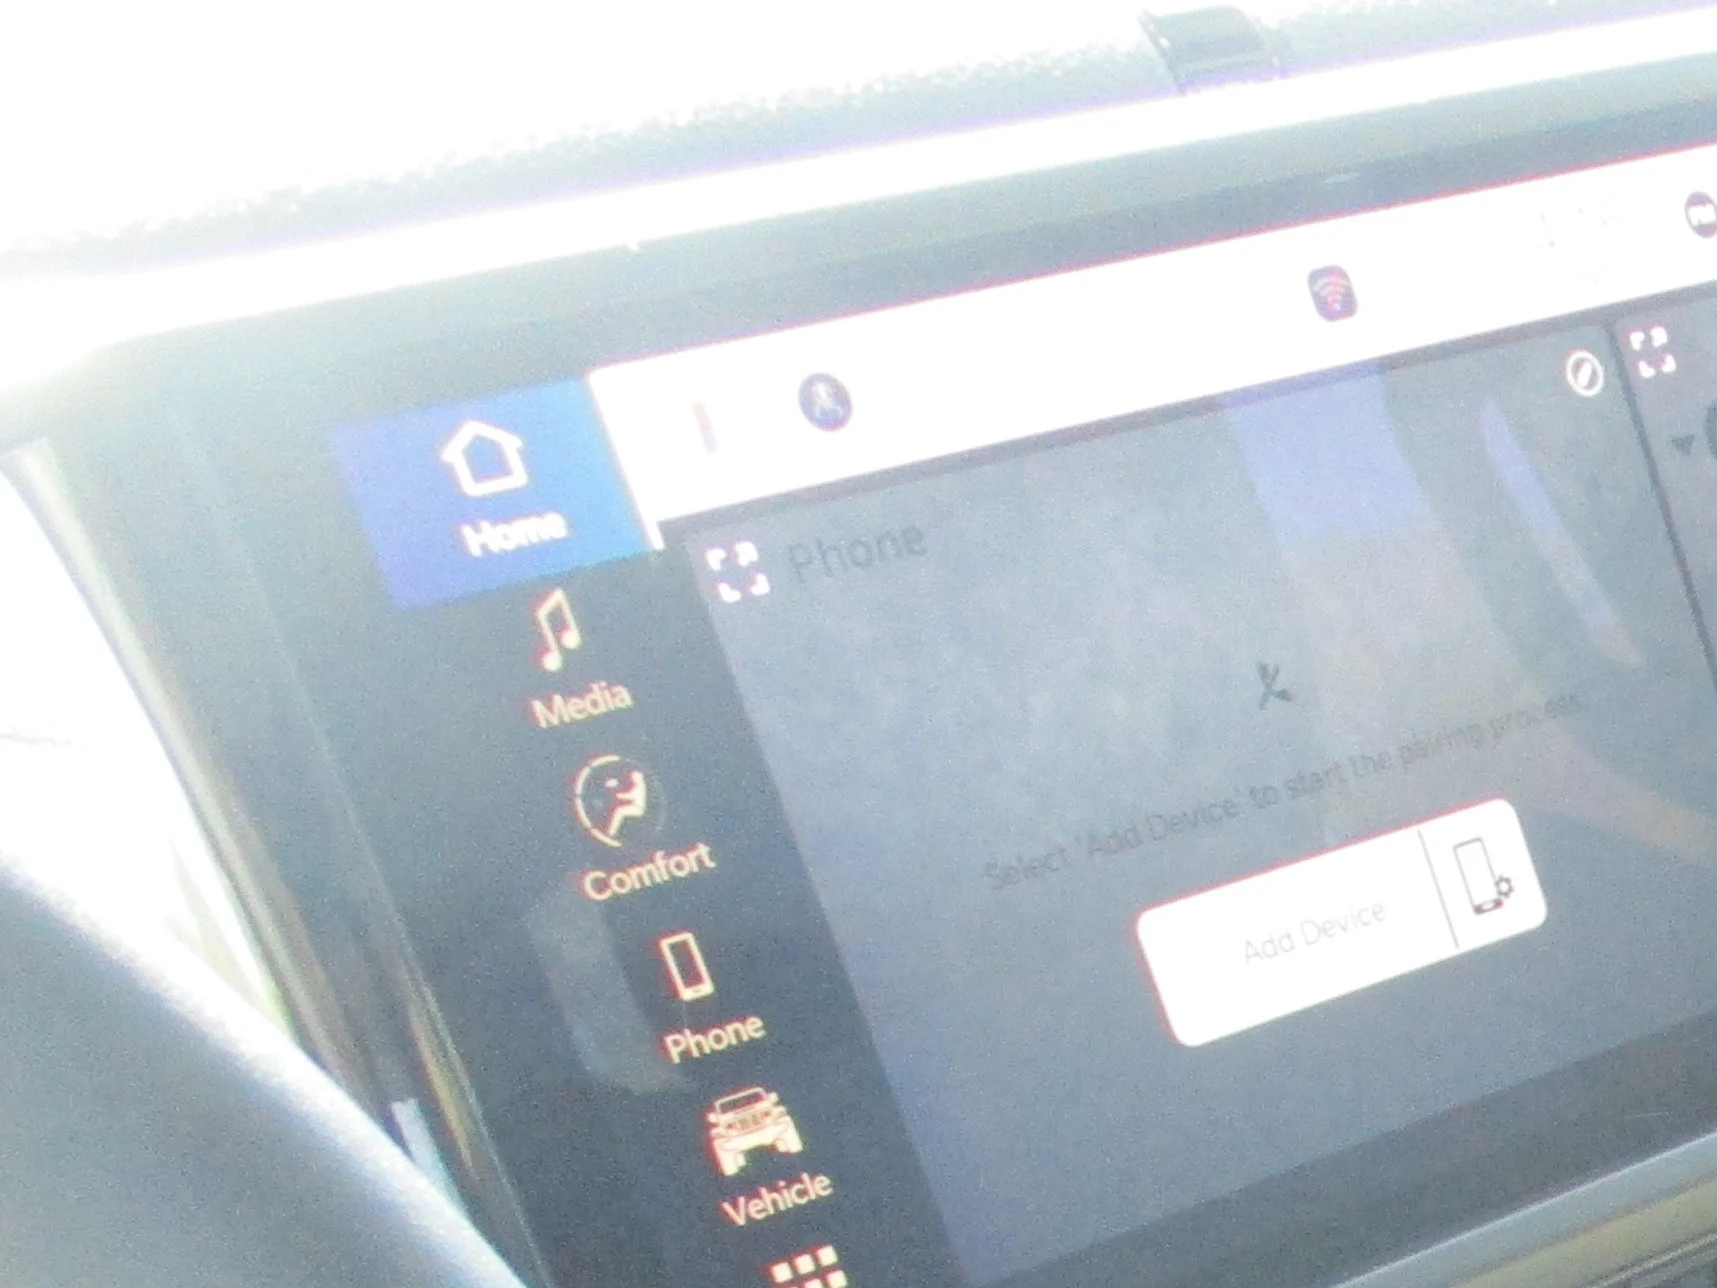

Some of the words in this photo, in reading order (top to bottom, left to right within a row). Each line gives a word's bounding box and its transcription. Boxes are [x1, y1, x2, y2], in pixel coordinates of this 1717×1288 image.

[460, 509, 569, 557] Home
[787, 524, 928, 585] Phone
[530, 681, 633, 728] Media
[583, 841, 718, 903] Comfort
[1243, 924, 1295, 967] Add
[1299, 901, 1387, 946] Device
[663, 1014, 766, 1063] Phone
[721, 1171, 834, 1227] Vehicle
